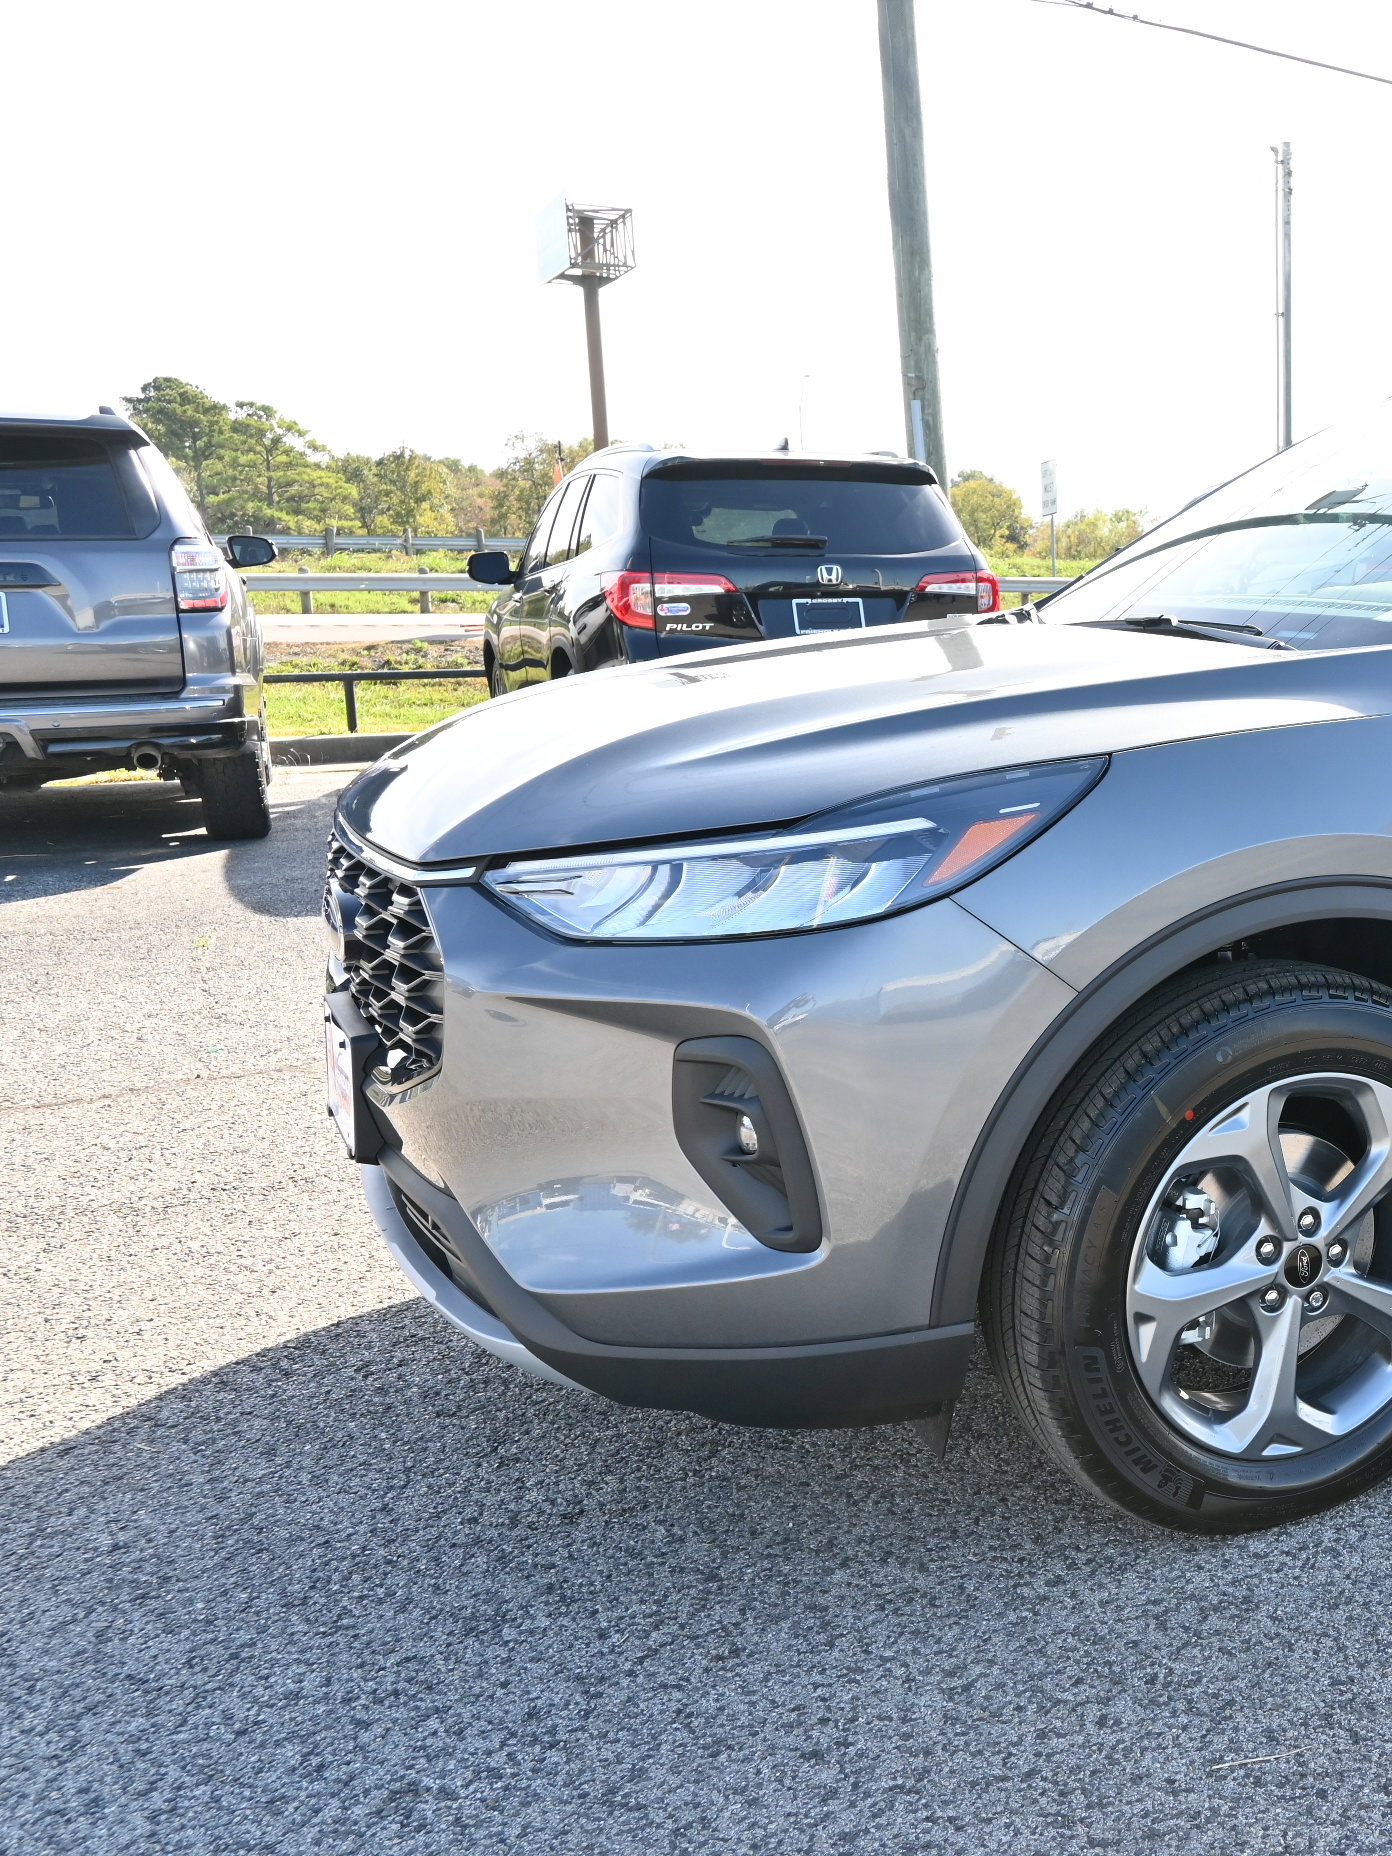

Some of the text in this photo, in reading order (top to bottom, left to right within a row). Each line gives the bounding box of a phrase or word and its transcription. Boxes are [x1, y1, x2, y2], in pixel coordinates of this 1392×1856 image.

[665, 623, 715, 631] PILOT
[1299, 1256, 1309, 1277] Ford
[1081, 1354, 1159, 1475] MICHELIN
